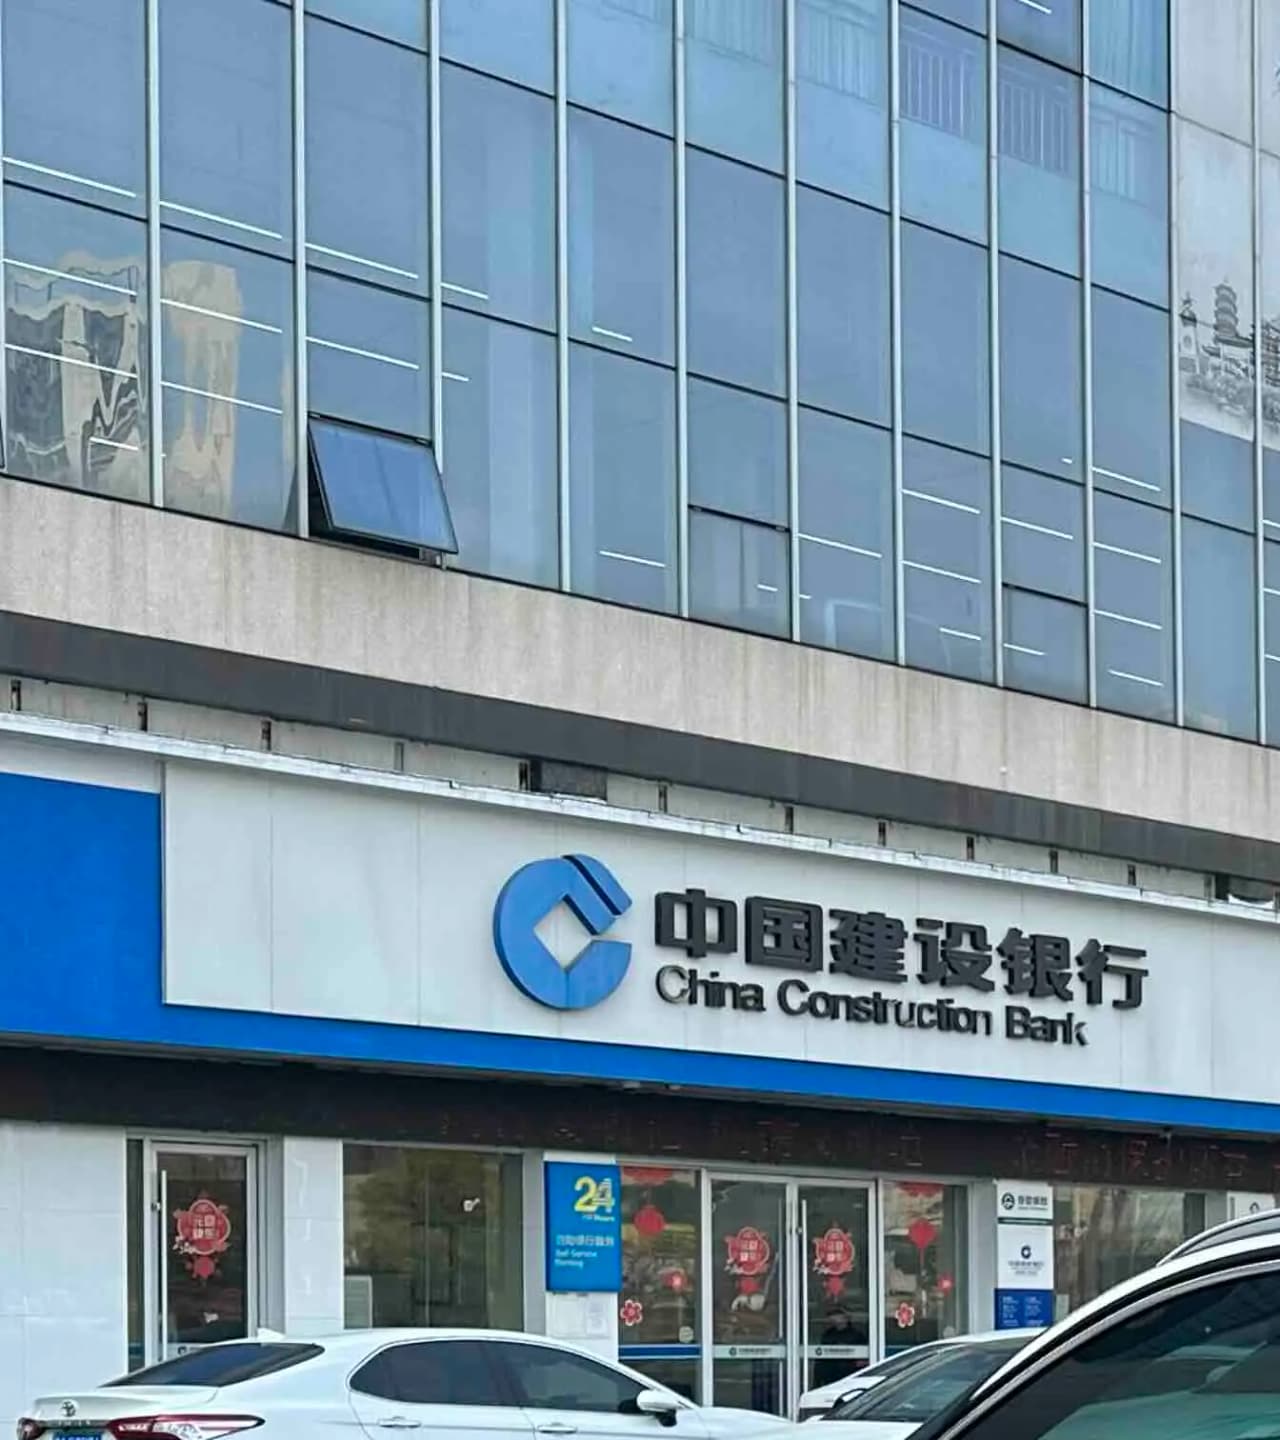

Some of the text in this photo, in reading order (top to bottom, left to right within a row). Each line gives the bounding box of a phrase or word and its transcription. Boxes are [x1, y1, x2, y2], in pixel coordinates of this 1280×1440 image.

[654, 887, 1149, 1010] 中国建设银行
[655, 964, 1090, 1047] China Construction Bank
[573, 1175, 616, 1213] 24
